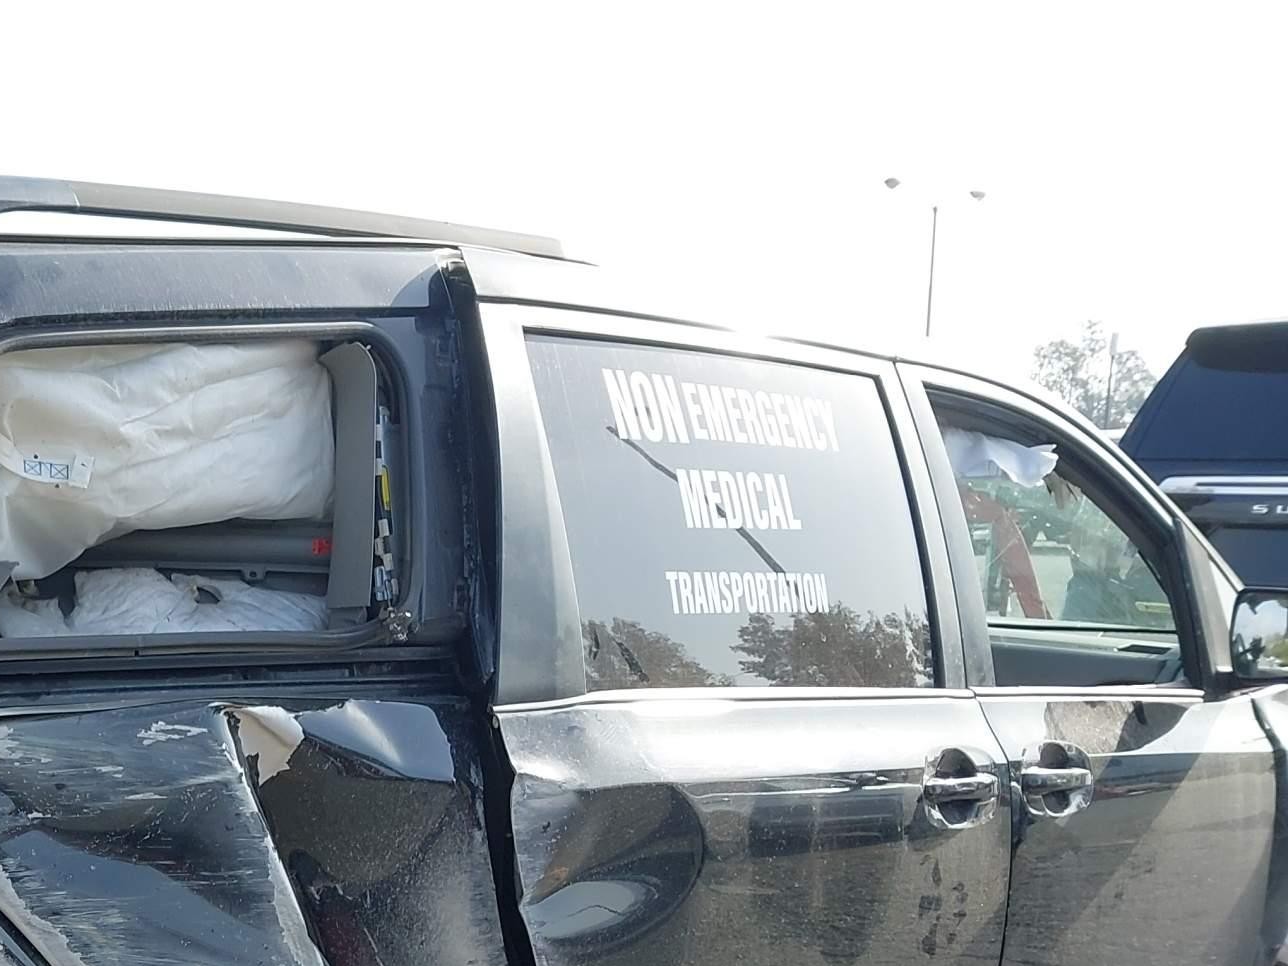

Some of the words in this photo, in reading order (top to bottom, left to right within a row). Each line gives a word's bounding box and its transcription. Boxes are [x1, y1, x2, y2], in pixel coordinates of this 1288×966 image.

[601, 368, 690, 444] NON
[680, 382, 840, 452] EMERGENCY
[675, 468, 802, 530] MEDICAL
[665, 571, 830, 614] TRANSPORTATION
